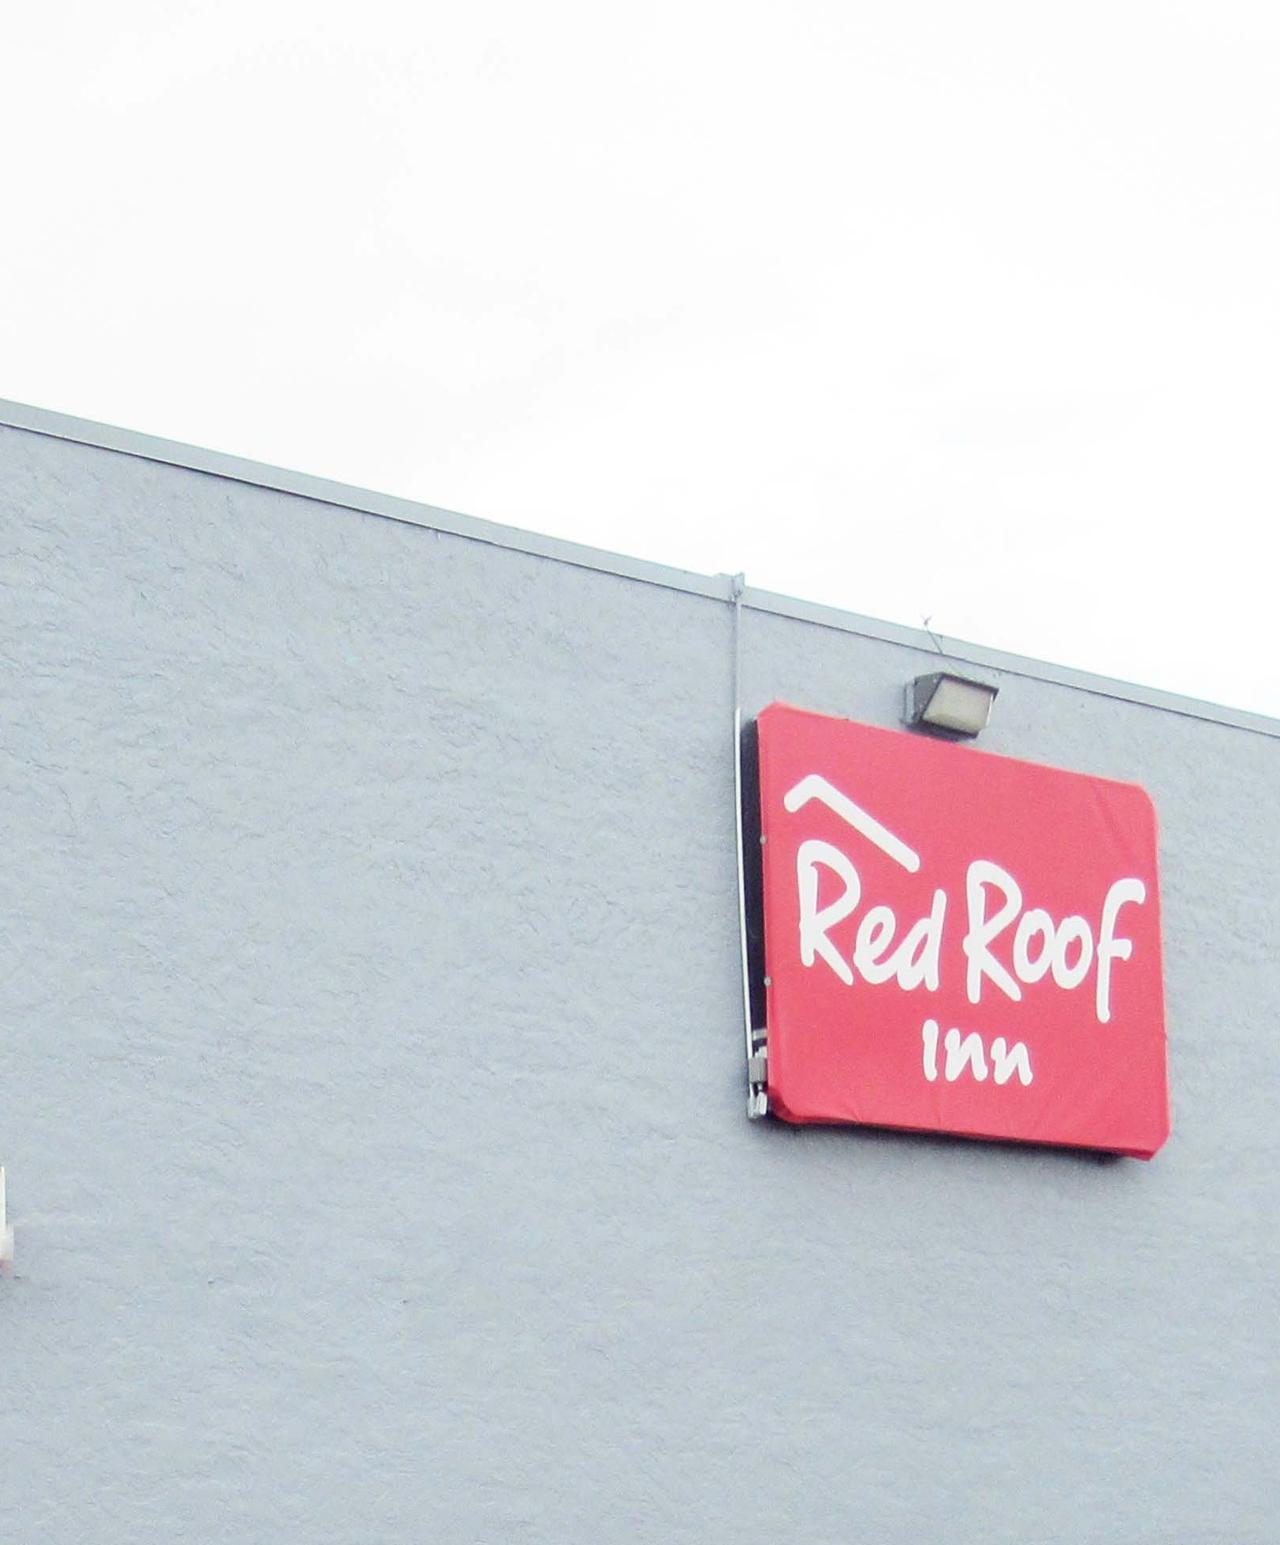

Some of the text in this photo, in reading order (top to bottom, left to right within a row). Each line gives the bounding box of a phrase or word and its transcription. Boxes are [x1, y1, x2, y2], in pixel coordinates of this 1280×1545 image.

[797, 839, 1146, 1023] Red Roof
[922, 1018, 1033, 1086] Inn
